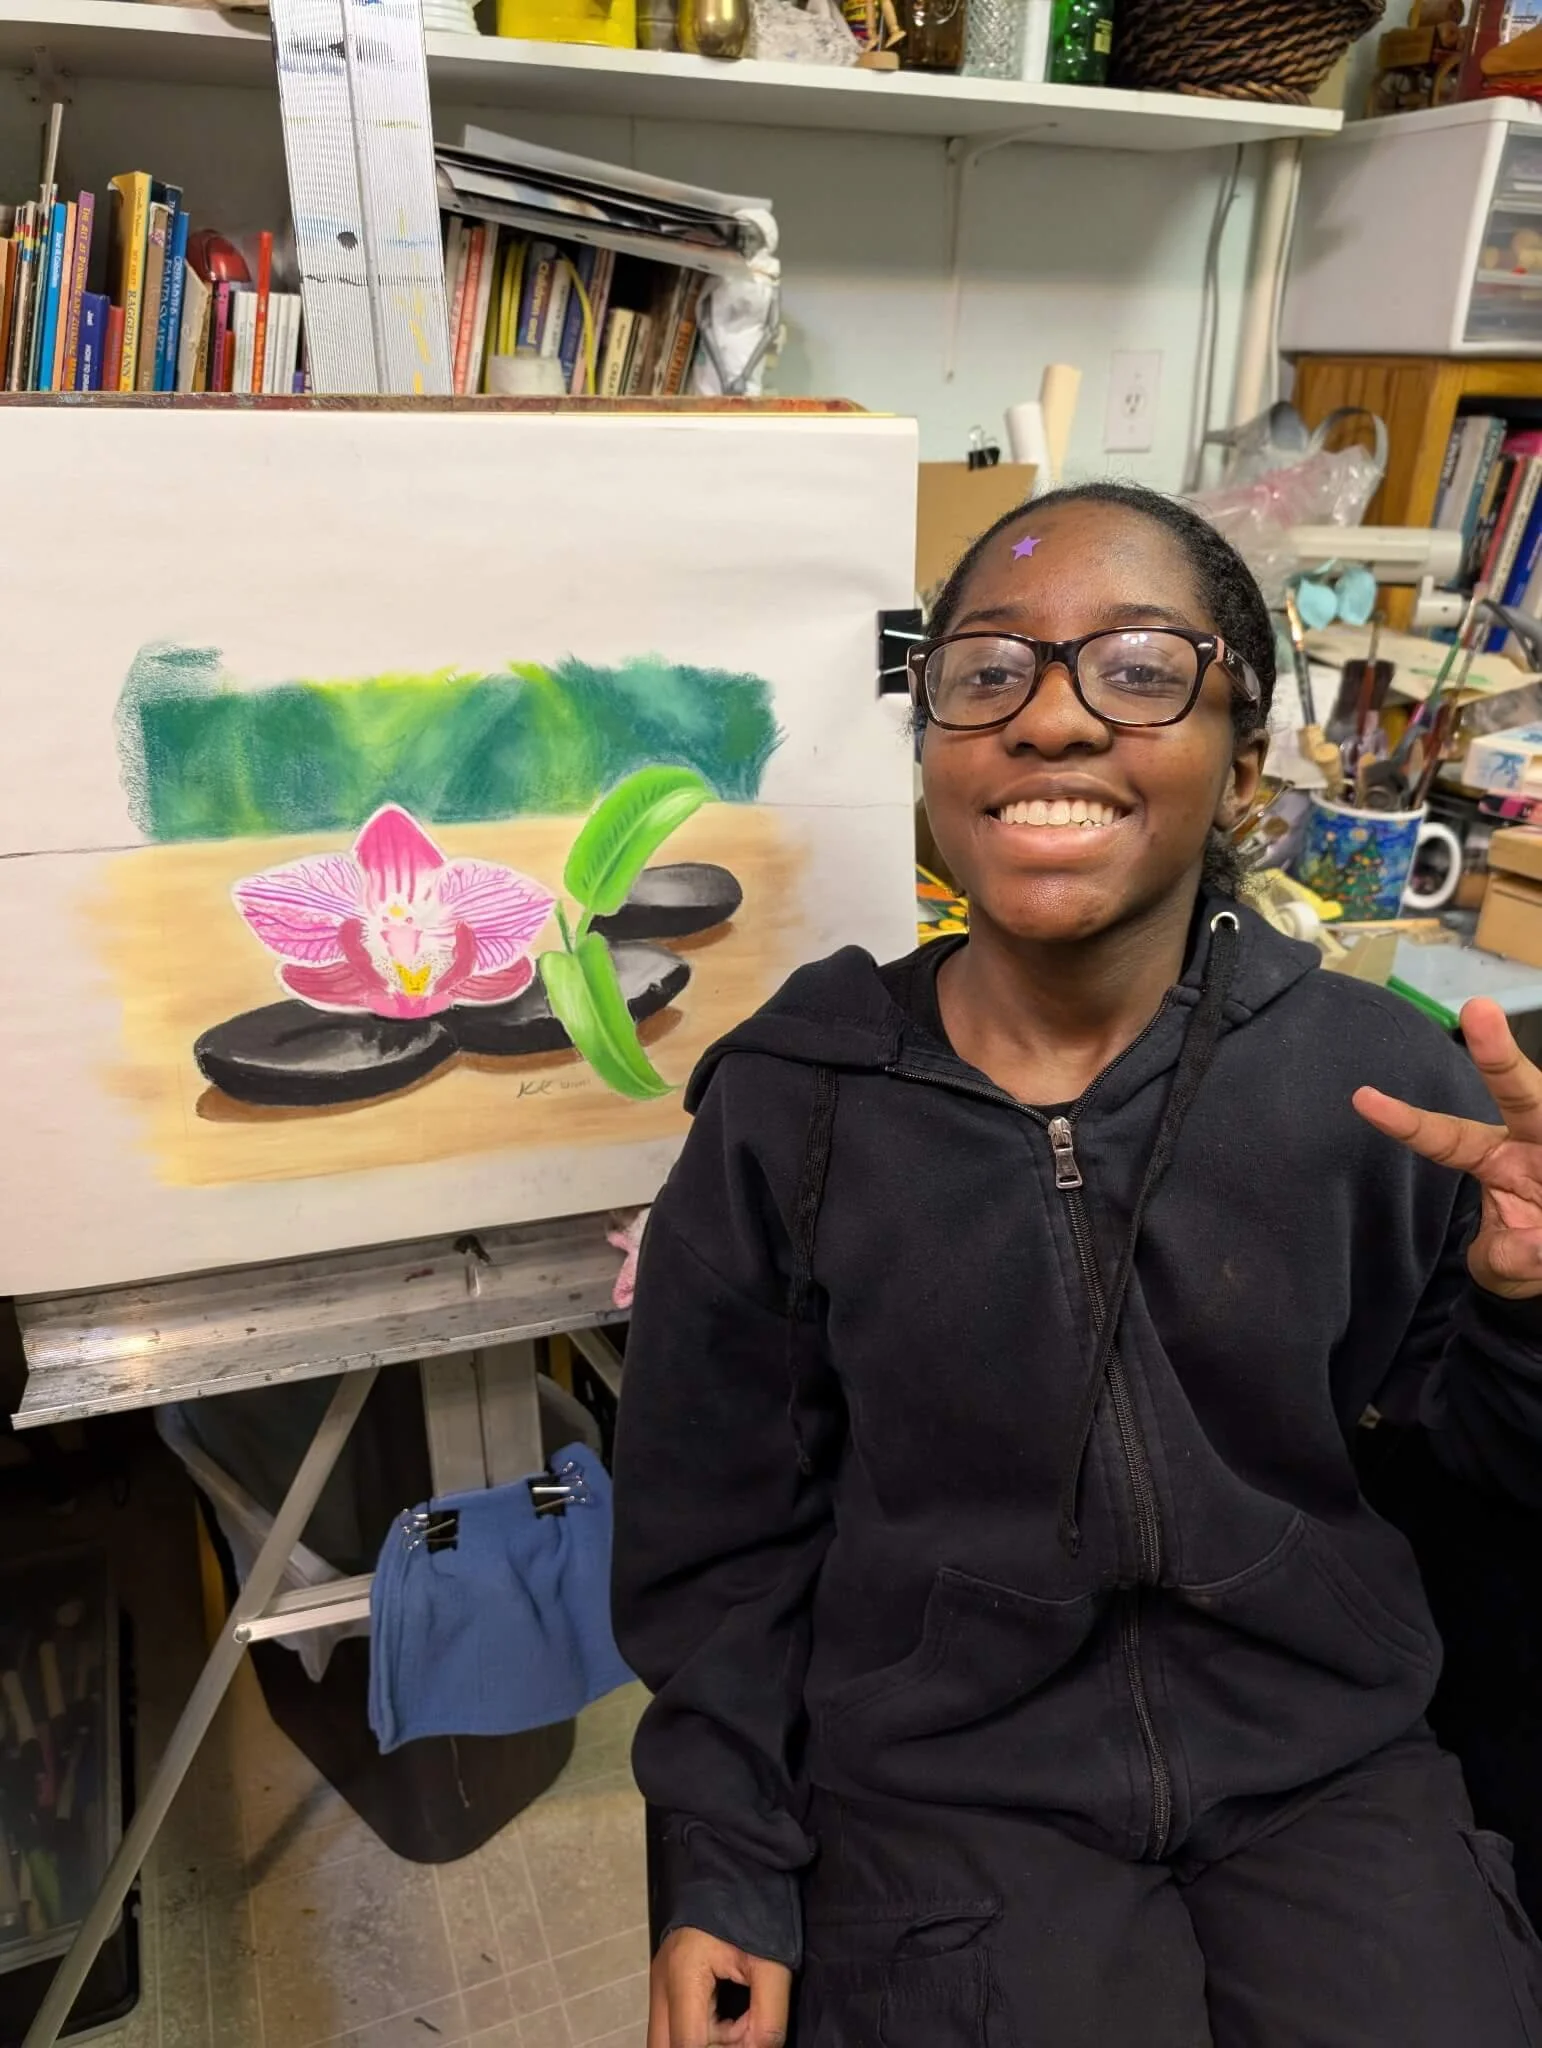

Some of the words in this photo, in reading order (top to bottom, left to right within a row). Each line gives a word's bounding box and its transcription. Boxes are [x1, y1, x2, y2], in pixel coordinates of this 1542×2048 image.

[82, 207, 91, 223] THE
[159, 259, 172, 326] FANTASY
[531, 261, 549, 316] Children
[126, 290, 138, 350] RAGGEDY
[527, 318, 538, 345] and
[84, 343, 92, 361] HOW
[156, 327, 166, 352] ART
[83, 361, 91, 373] TO
[121, 350, 133, 377] ANN
